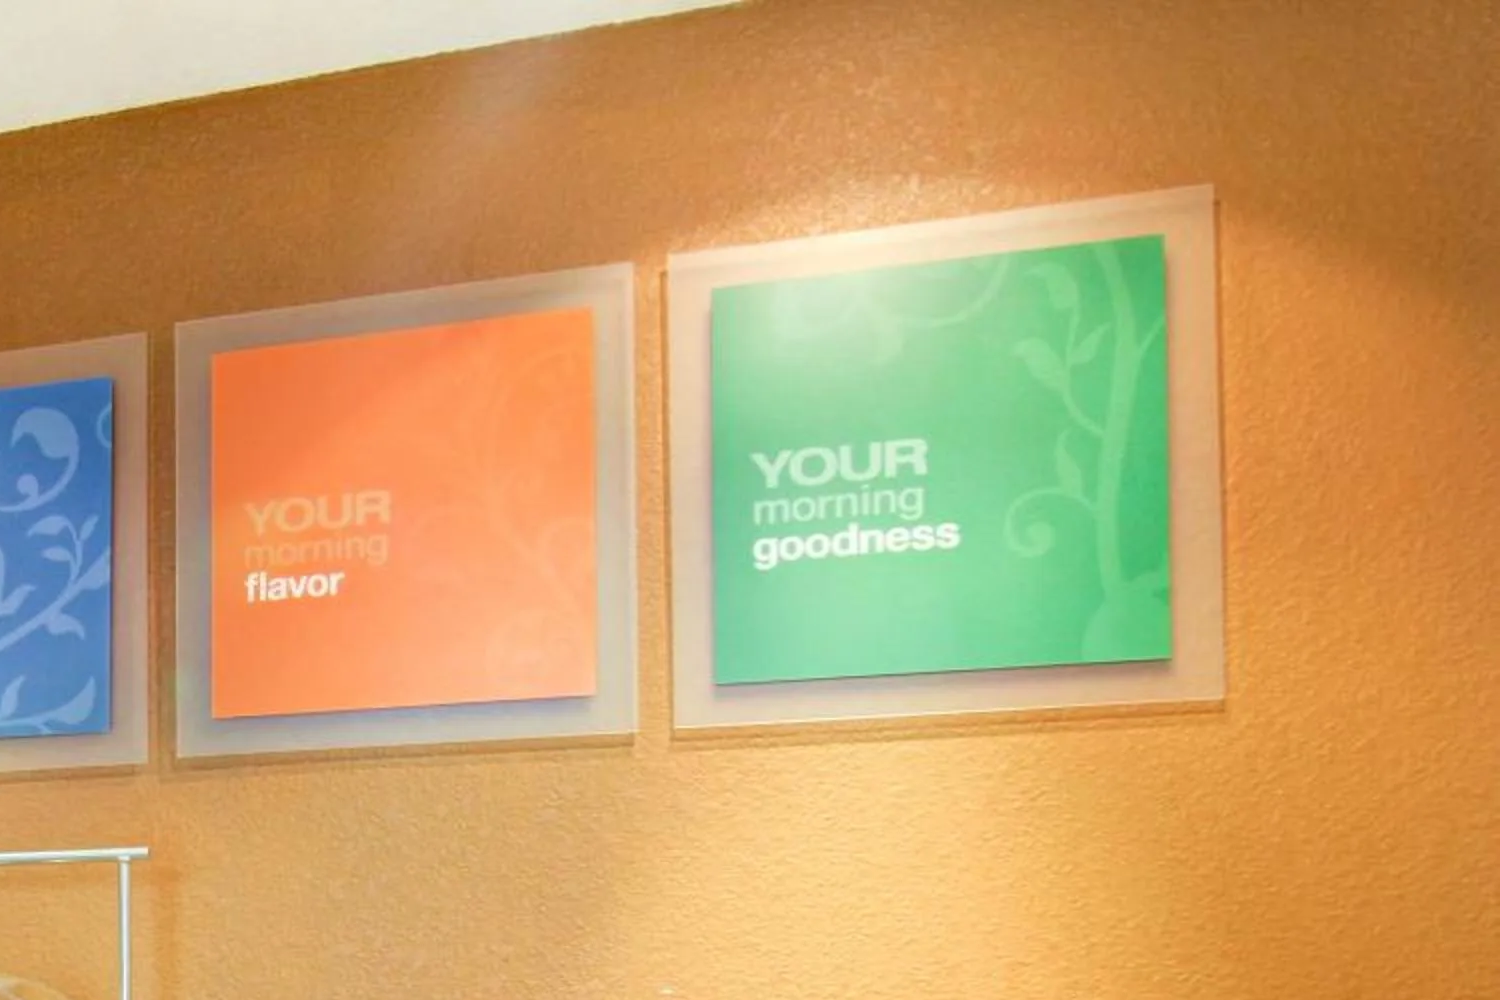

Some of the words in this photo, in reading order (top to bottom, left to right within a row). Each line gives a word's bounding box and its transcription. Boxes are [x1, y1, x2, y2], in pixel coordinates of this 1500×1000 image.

[751, 438, 929, 488] YOUR
[245, 490, 391, 536] YOUR
[753, 484, 925, 526] morning
[244, 530, 389, 571] morning
[753, 522, 961, 571] goodness
[244, 571, 345, 603] flavor
